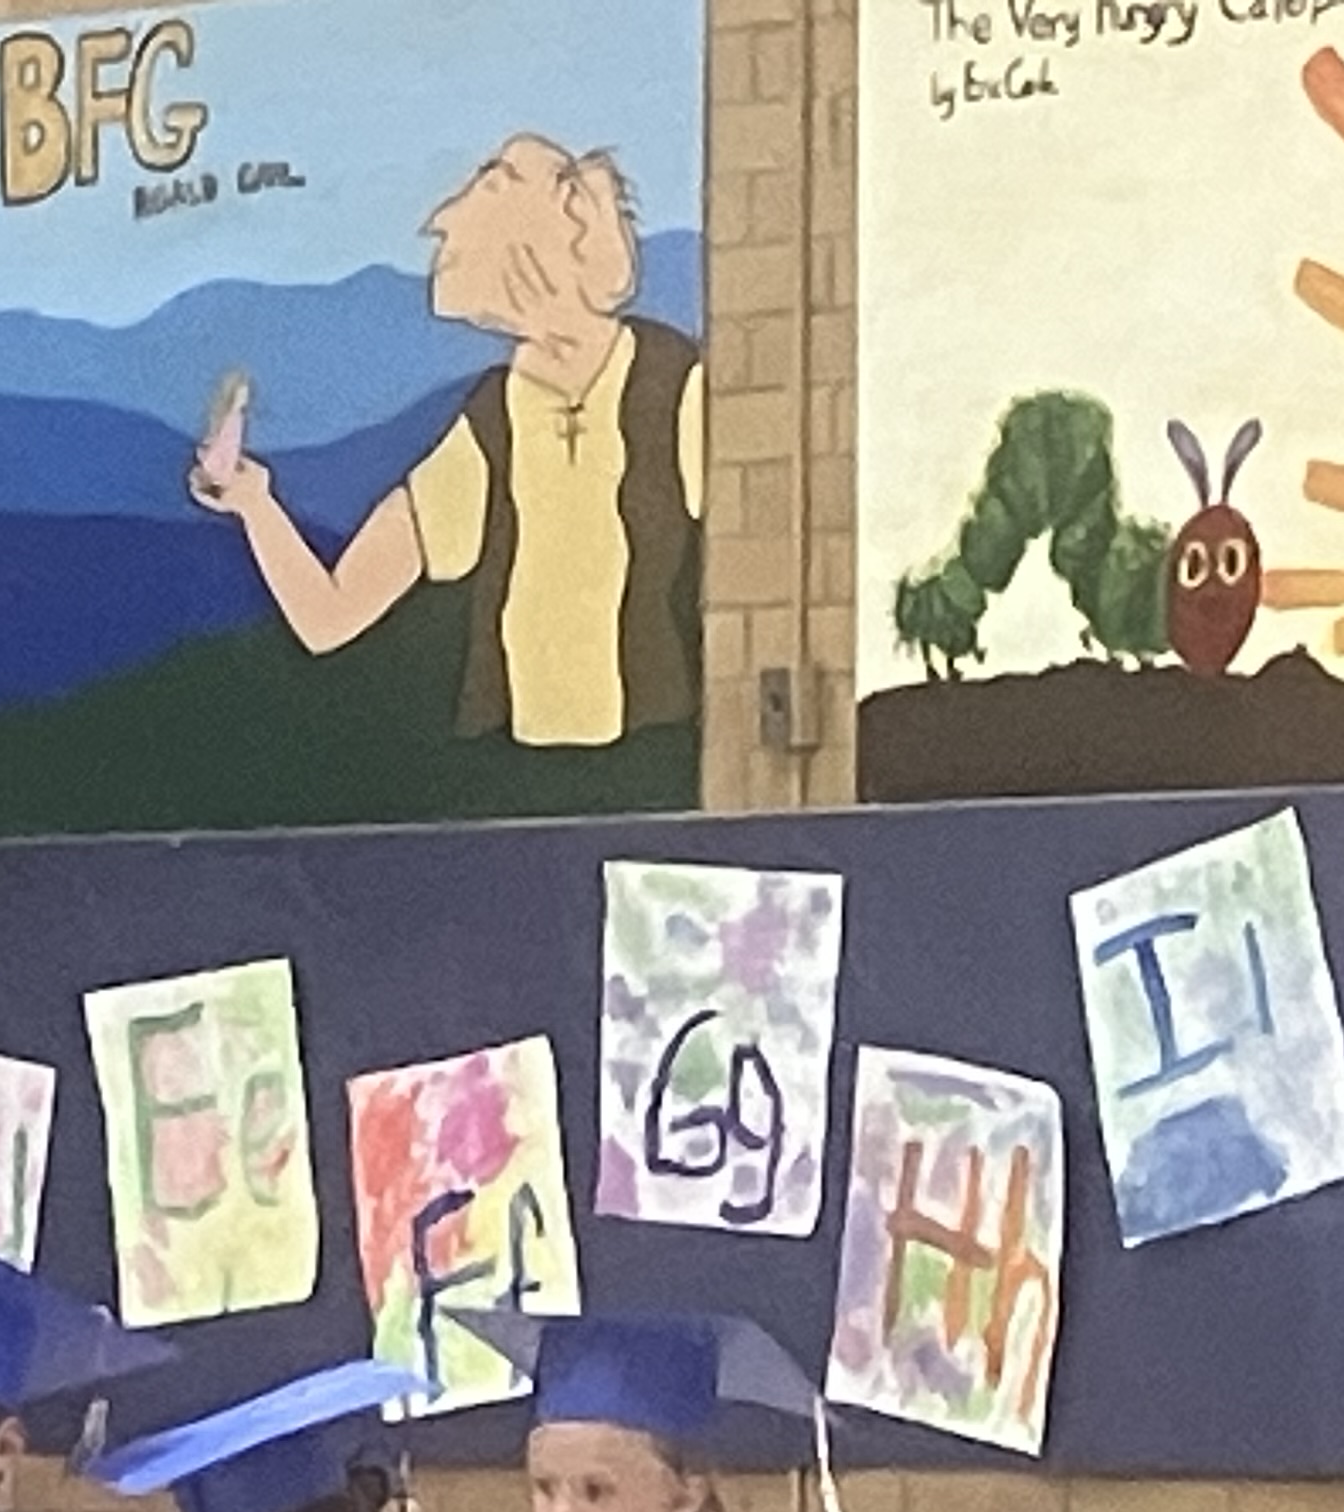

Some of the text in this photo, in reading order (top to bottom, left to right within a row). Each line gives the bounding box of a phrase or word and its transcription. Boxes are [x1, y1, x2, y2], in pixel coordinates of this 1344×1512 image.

[918, 0, 992, 45] The
[1006, 0, 1081, 49] Very
[929, 70, 957, 122] by
